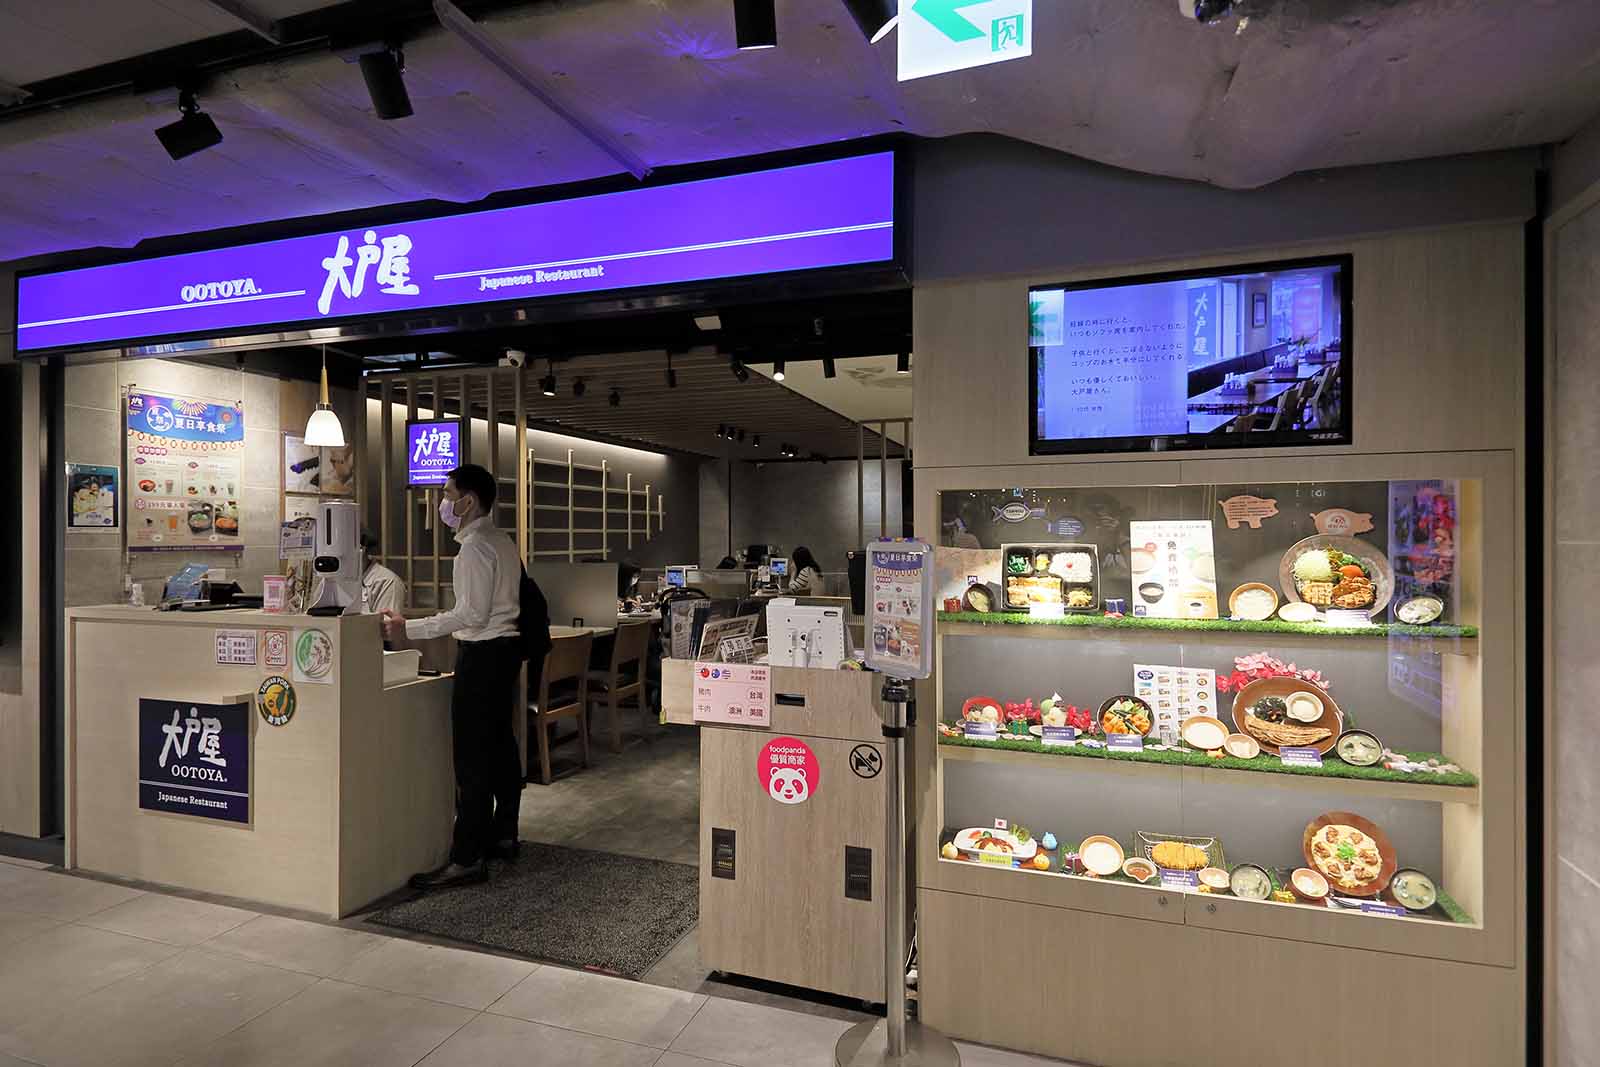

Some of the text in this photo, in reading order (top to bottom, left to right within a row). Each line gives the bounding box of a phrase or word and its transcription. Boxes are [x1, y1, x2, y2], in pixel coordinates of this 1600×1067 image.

[479, 265, 605, 291] Japanese Restaurant
[749, 690, 764, 700] 台灣
[769, 745, 806, 757] foodpanda
[770, 755, 806, 766] 優質商家
[158, 791, 228, 809] Japanese Restaurant
